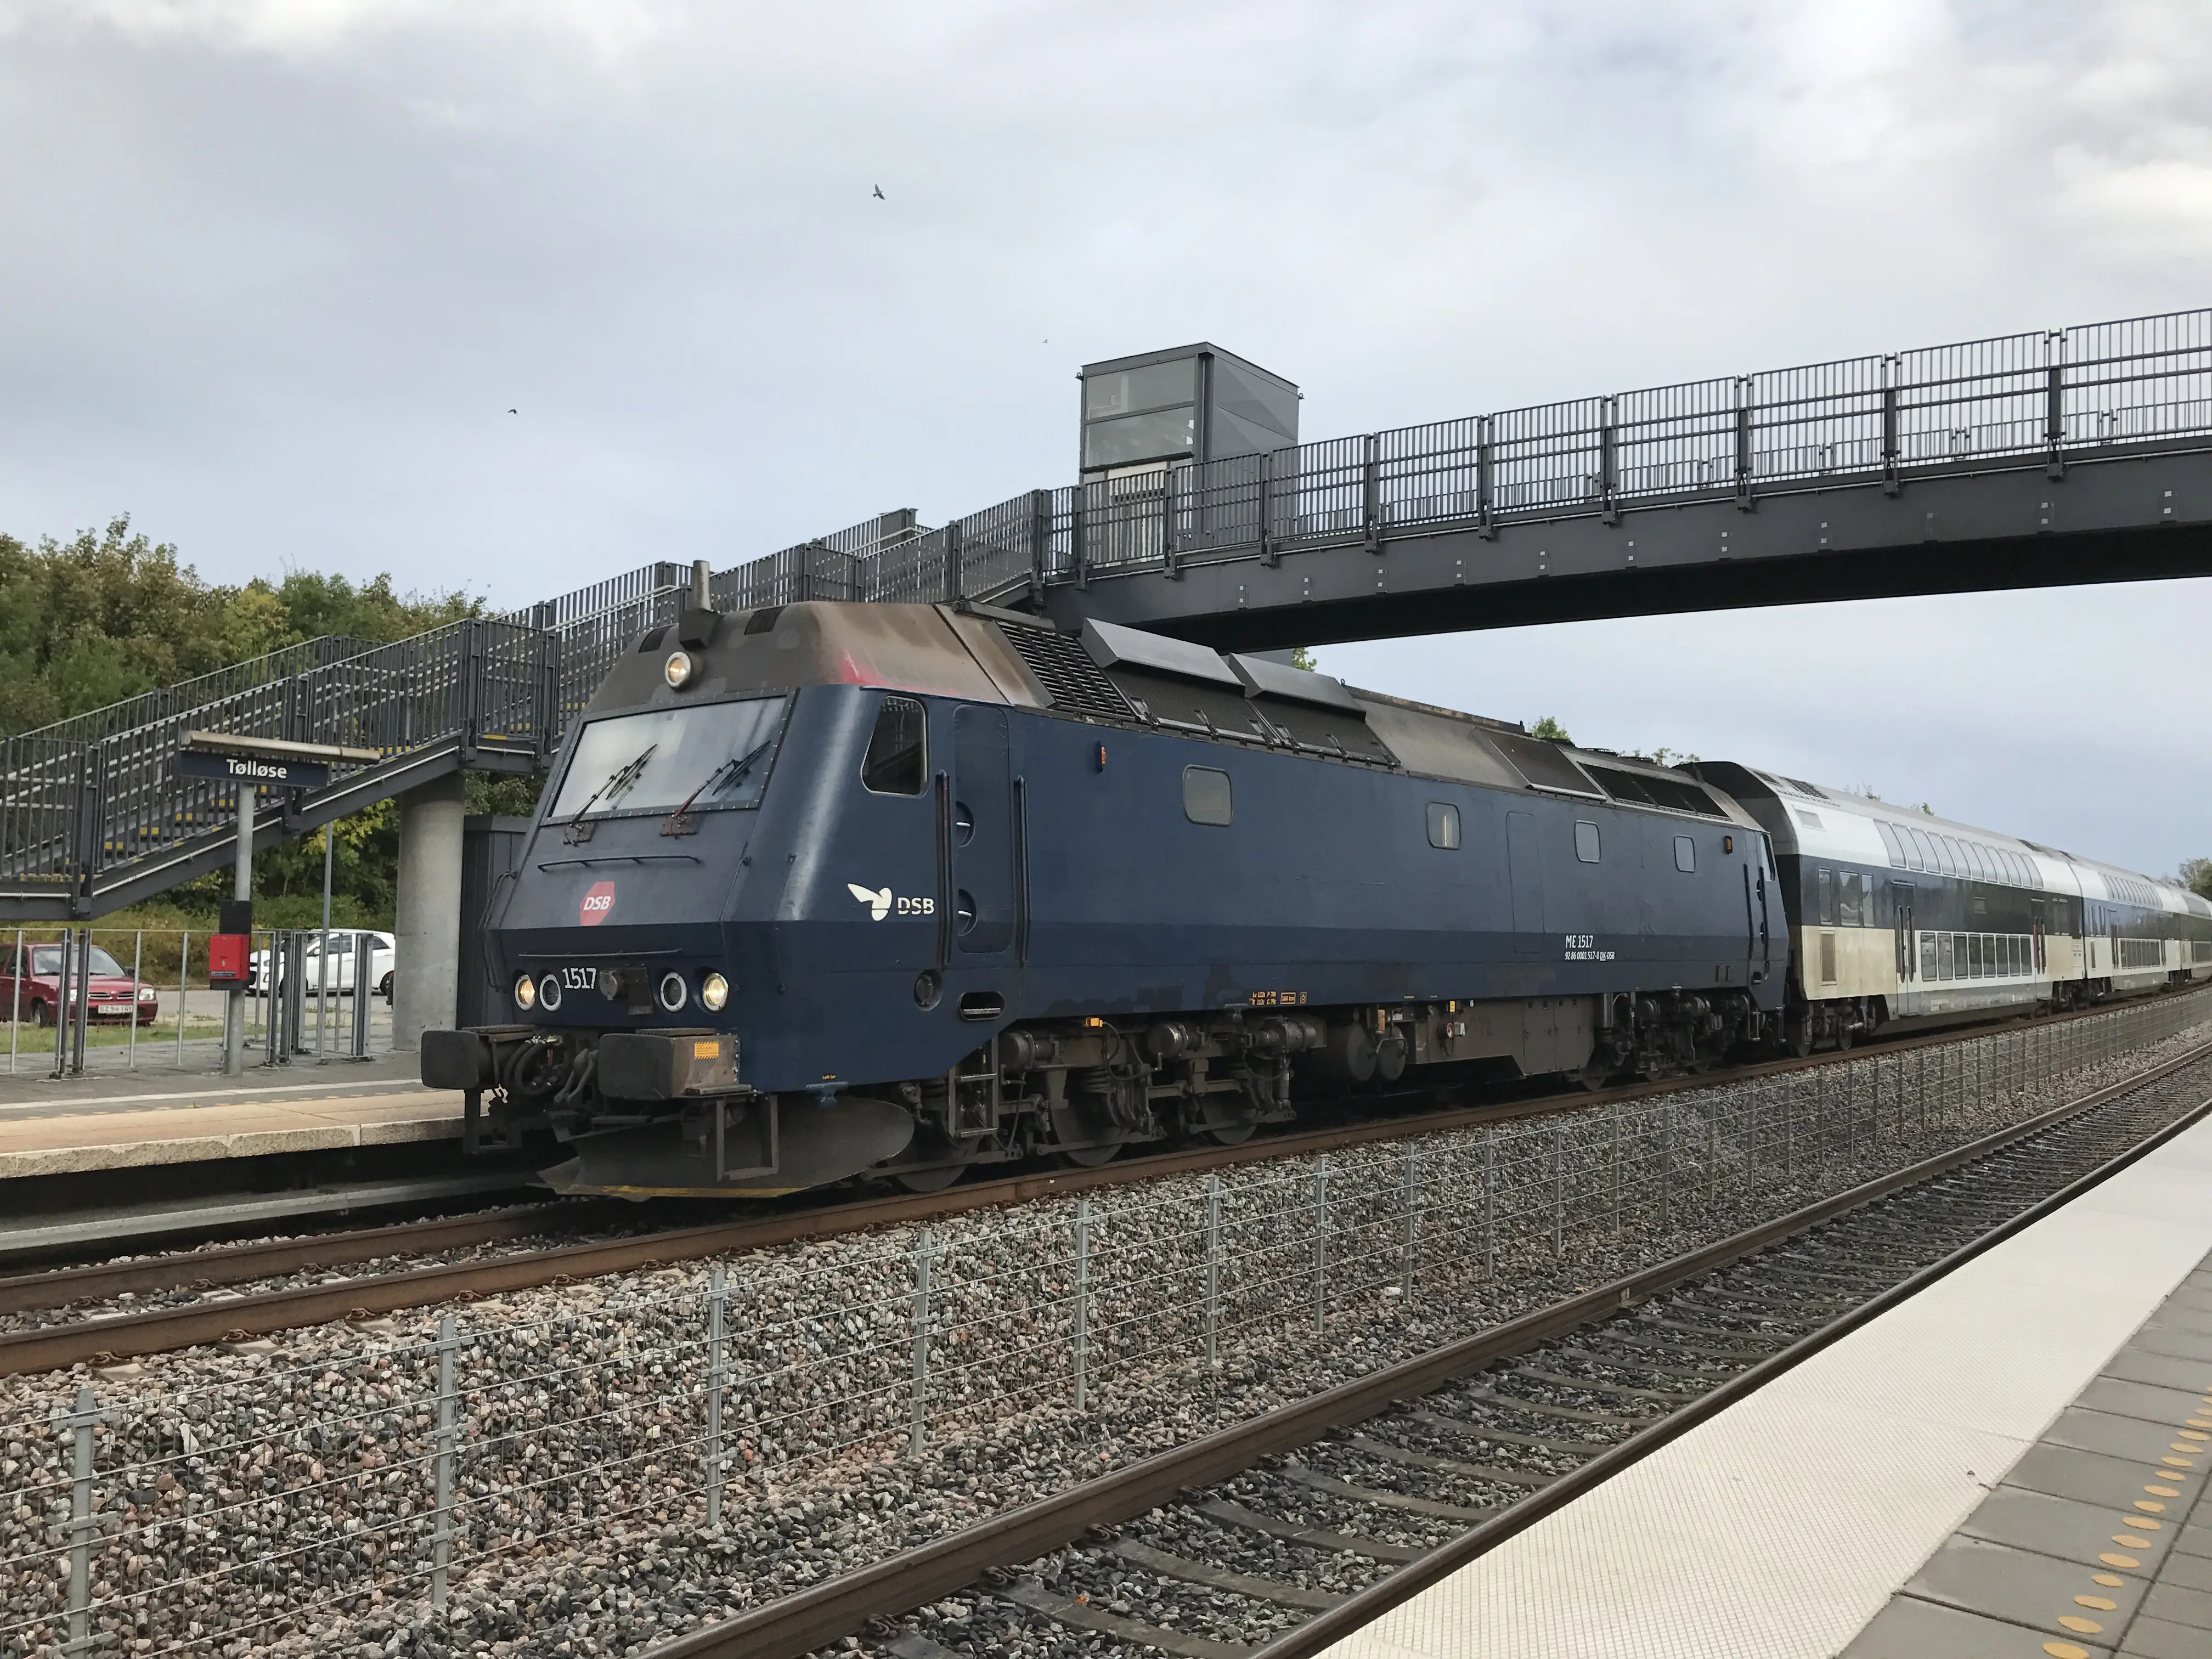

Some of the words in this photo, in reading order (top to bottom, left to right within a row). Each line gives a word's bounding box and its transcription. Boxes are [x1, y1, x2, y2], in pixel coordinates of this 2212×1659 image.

[226, 758, 287, 778] Tølløse
[583, 896, 611, 911] DSB
[898, 897, 934, 915] DSB
[1565, 935, 1577, 949] ME
[1577, 935, 1594, 949] 1517
[1565, 951, 1571, 960] 92
[1571, 951, 1577, 960] 86
[1577, 951, 1587, 960] 0001
[1587, 951, 1600, 960] 517-8
[1599, 951, 1615, 961] DK-DSB
[562, 968, 596, 990] 1517
